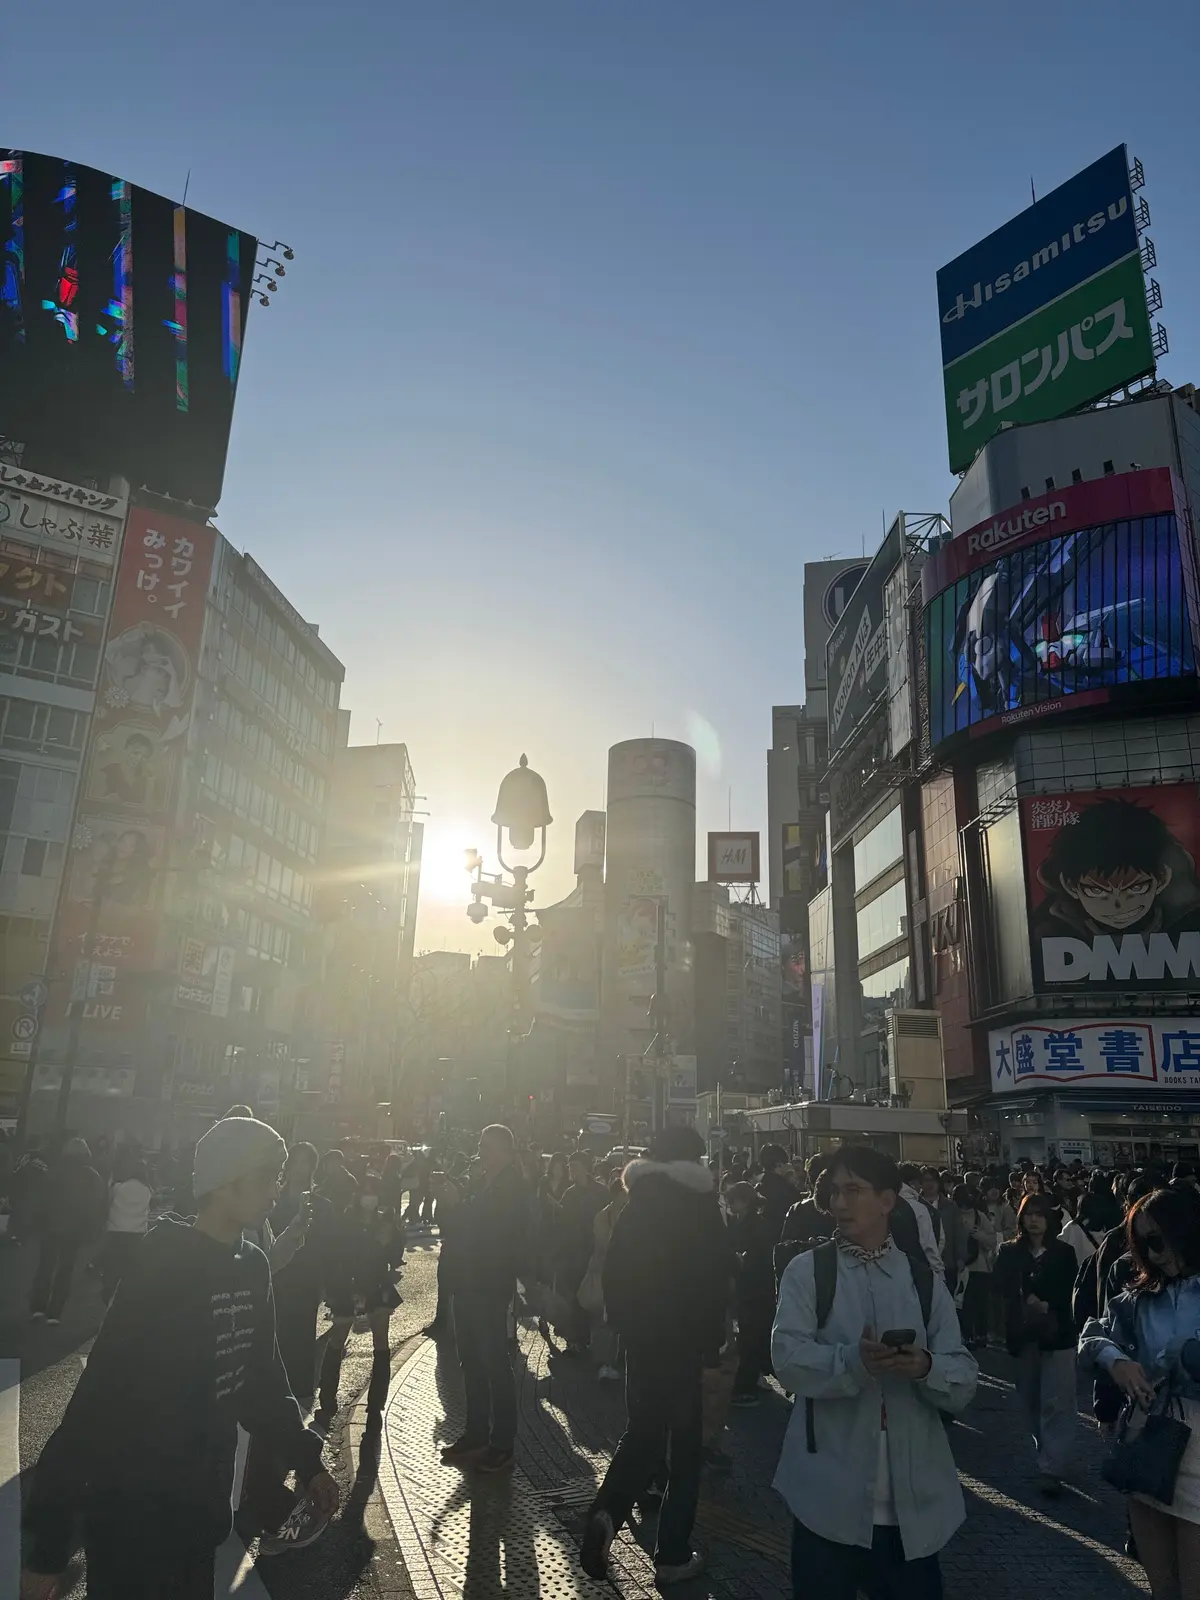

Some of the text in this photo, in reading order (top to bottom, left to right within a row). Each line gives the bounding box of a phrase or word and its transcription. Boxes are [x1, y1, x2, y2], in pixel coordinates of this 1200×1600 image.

[942, 196, 1128, 323] Hisamitsu
[956, 298, 1134, 430] サロンパス
[20, 503, 114, 548] しゃぶ葉
[967, 500, 1067, 556] Rakuten
[164, 536, 195, 620] カワイイ
[12, 609, 84, 641] ガスト
[1001, 700, 1062, 724] Rakuten Vision
[82, 1003, 123, 1020] LIVE
[995, 1029, 1200, 1080] 大盛堂書店
[1164, 1076, 1200, 1084] BOOKS TA
[1132, 1104, 1182, 1112] TAISEIDO
